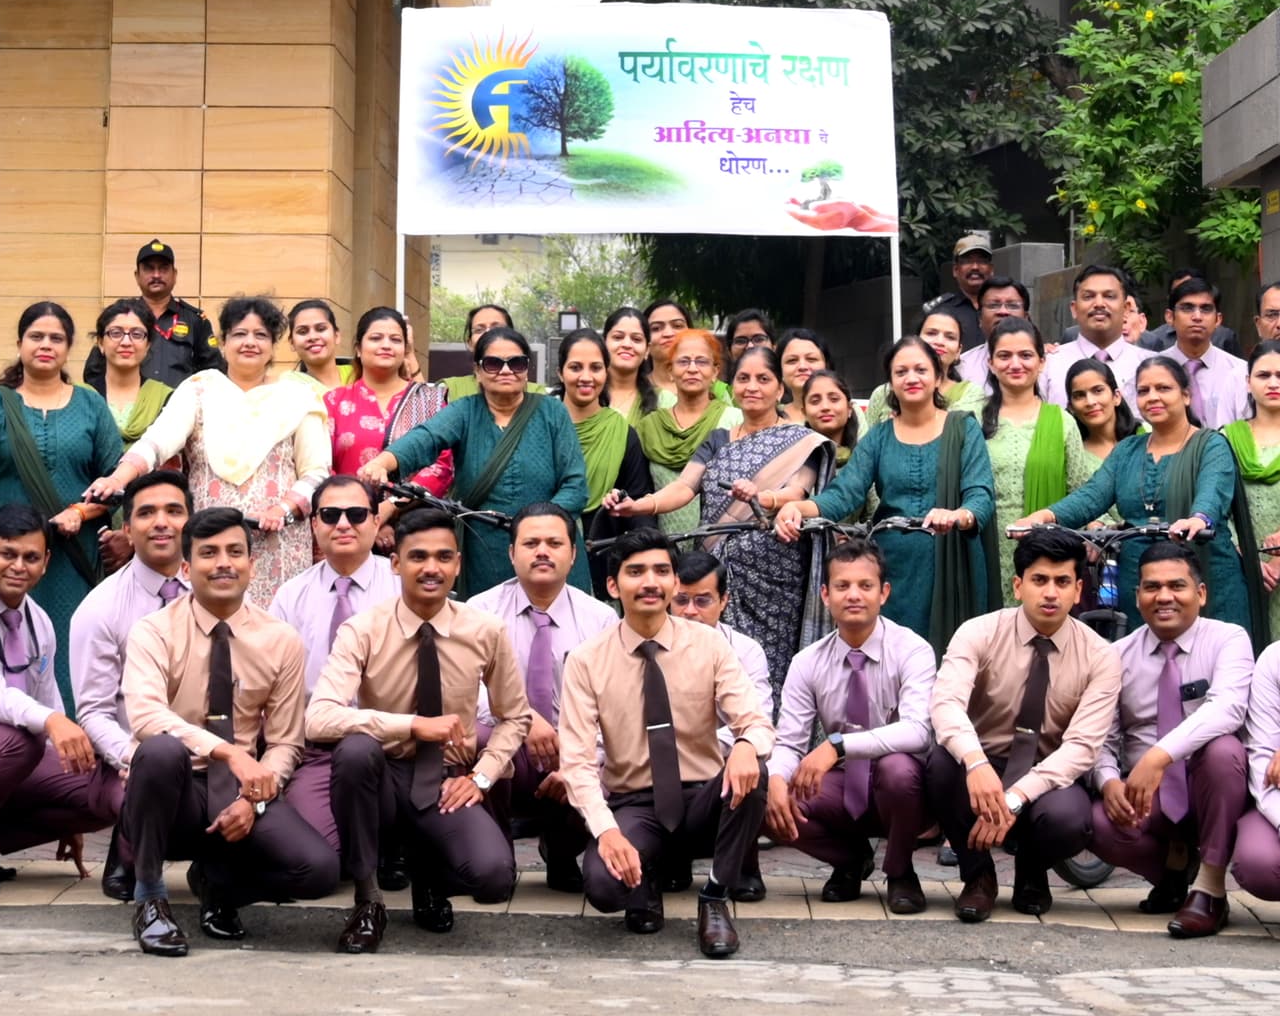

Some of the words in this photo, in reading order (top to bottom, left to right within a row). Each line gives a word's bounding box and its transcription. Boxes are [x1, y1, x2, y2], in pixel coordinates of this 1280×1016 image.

[618, 37, 772, 86] पर्यावरणाचे
[781, 55, 850, 88] रक्षण
[730, 91, 756, 115] हेच
[654, 120, 810, 144] आदित्य-अनघा
